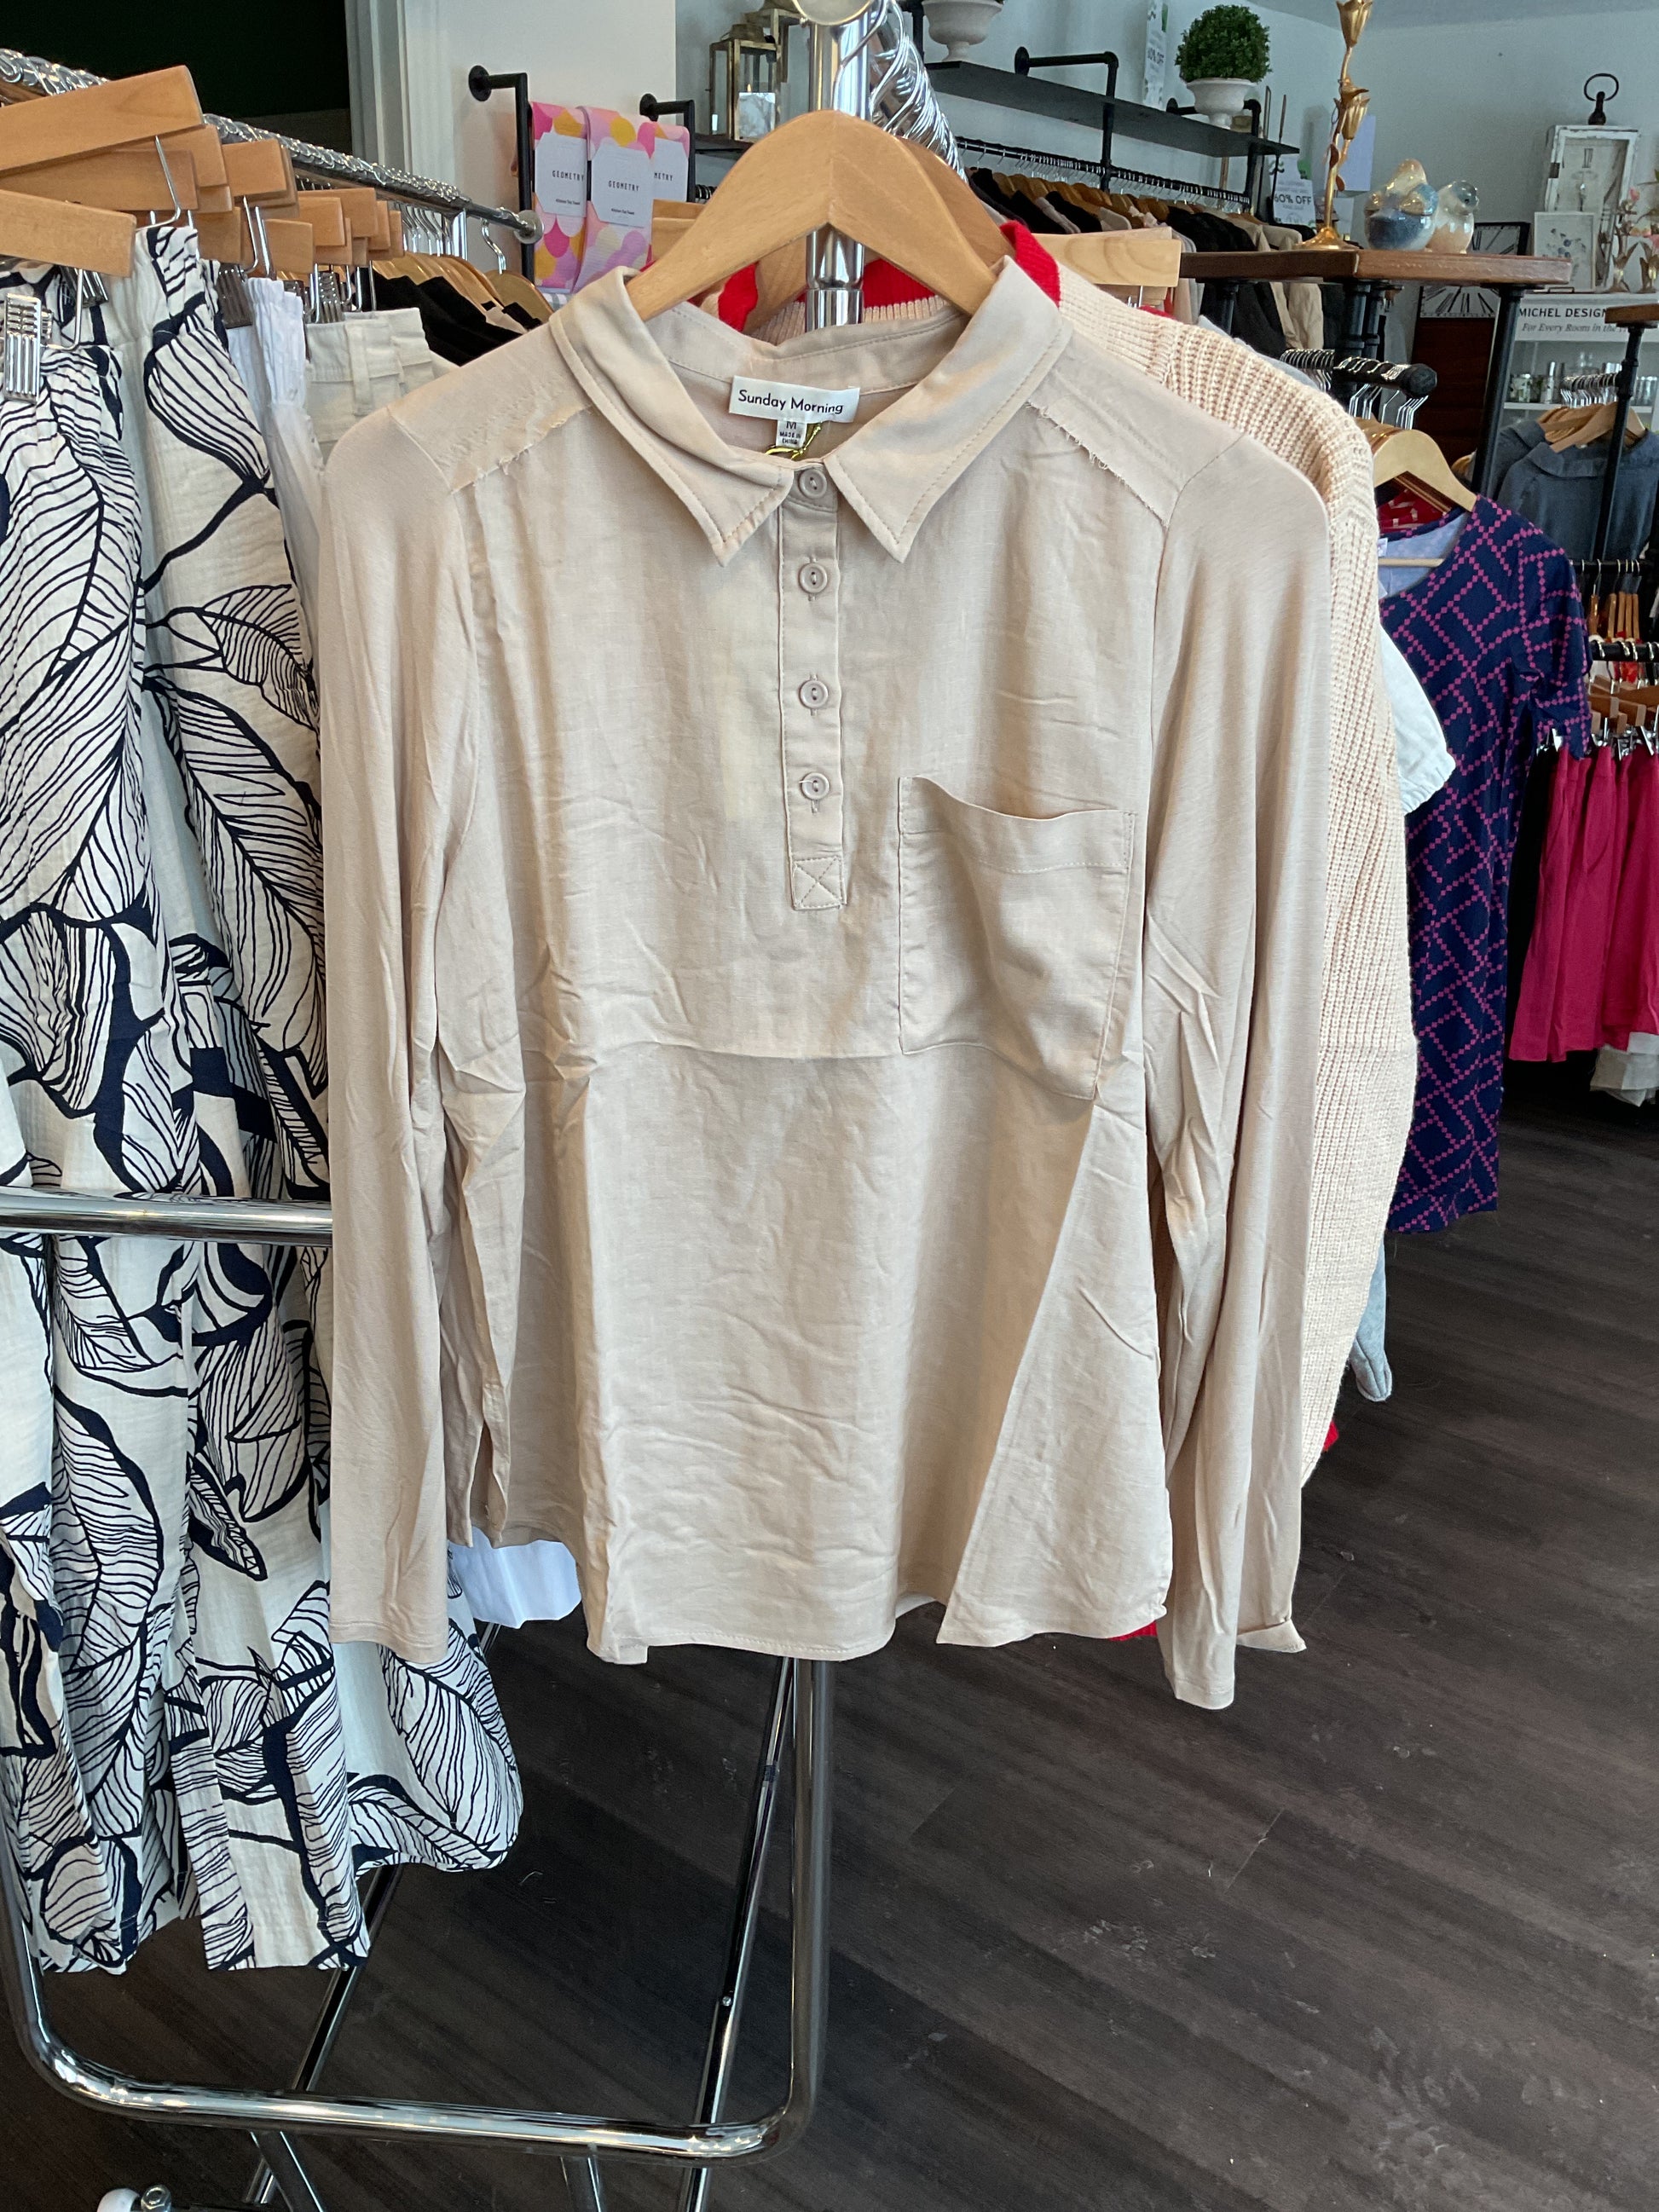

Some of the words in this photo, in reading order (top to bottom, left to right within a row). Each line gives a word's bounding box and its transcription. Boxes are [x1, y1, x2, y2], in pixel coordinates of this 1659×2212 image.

[552, 170, 584, 182] GEOMETRY
[654, 172, 673, 181] METRY
[608, 180, 639, 191] GEOMETRY
[1275, 193, 1293, 204] 60%
[1296, 195, 1312, 205] OFF
[1519, 308, 1561, 318] MICHEL
[1522, 324, 1535, 332] For
[1538, 324, 1562, 333] Every
[1564, 324, 1590, 332] Room
[1592, 323, 1601, 332] in
[738, 390, 786, 410] Sunday
[790, 397, 843, 414] Morning
[786, 421, 796, 430] M
